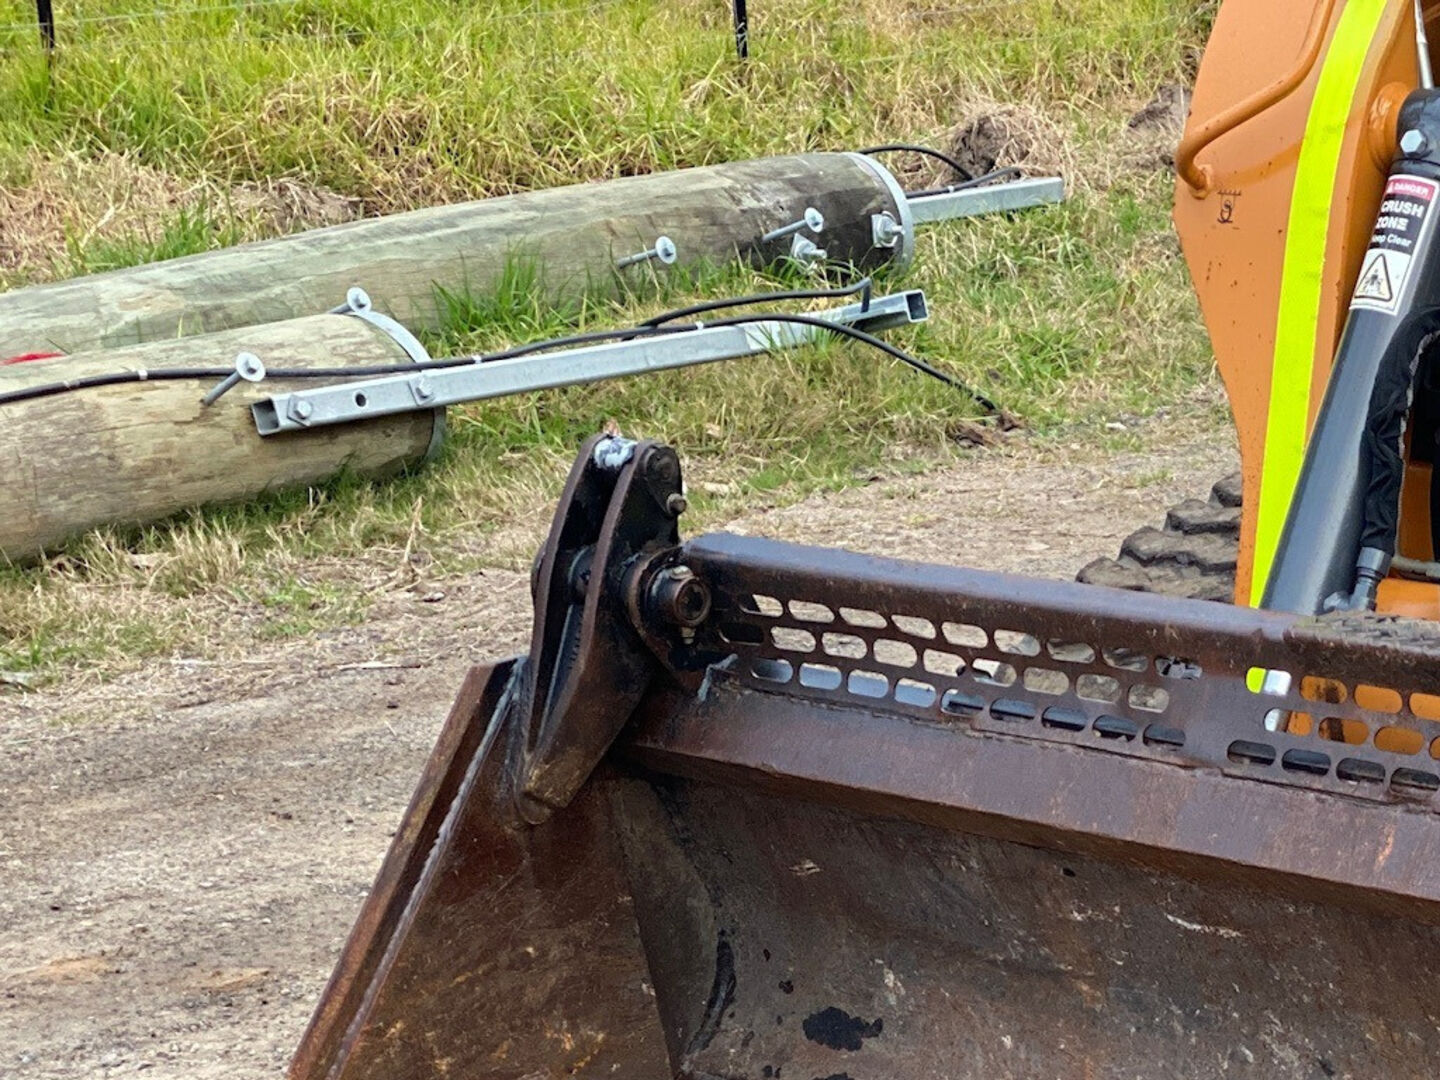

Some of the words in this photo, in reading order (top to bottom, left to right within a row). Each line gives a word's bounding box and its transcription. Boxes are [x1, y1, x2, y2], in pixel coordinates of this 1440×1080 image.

[1394, 182, 1429, 196] DANGER
[1381, 200, 1425, 218] CRUSH
[1376, 216, 1409, 231] ZONE
[1387, 233, 1412, 248] Clear
